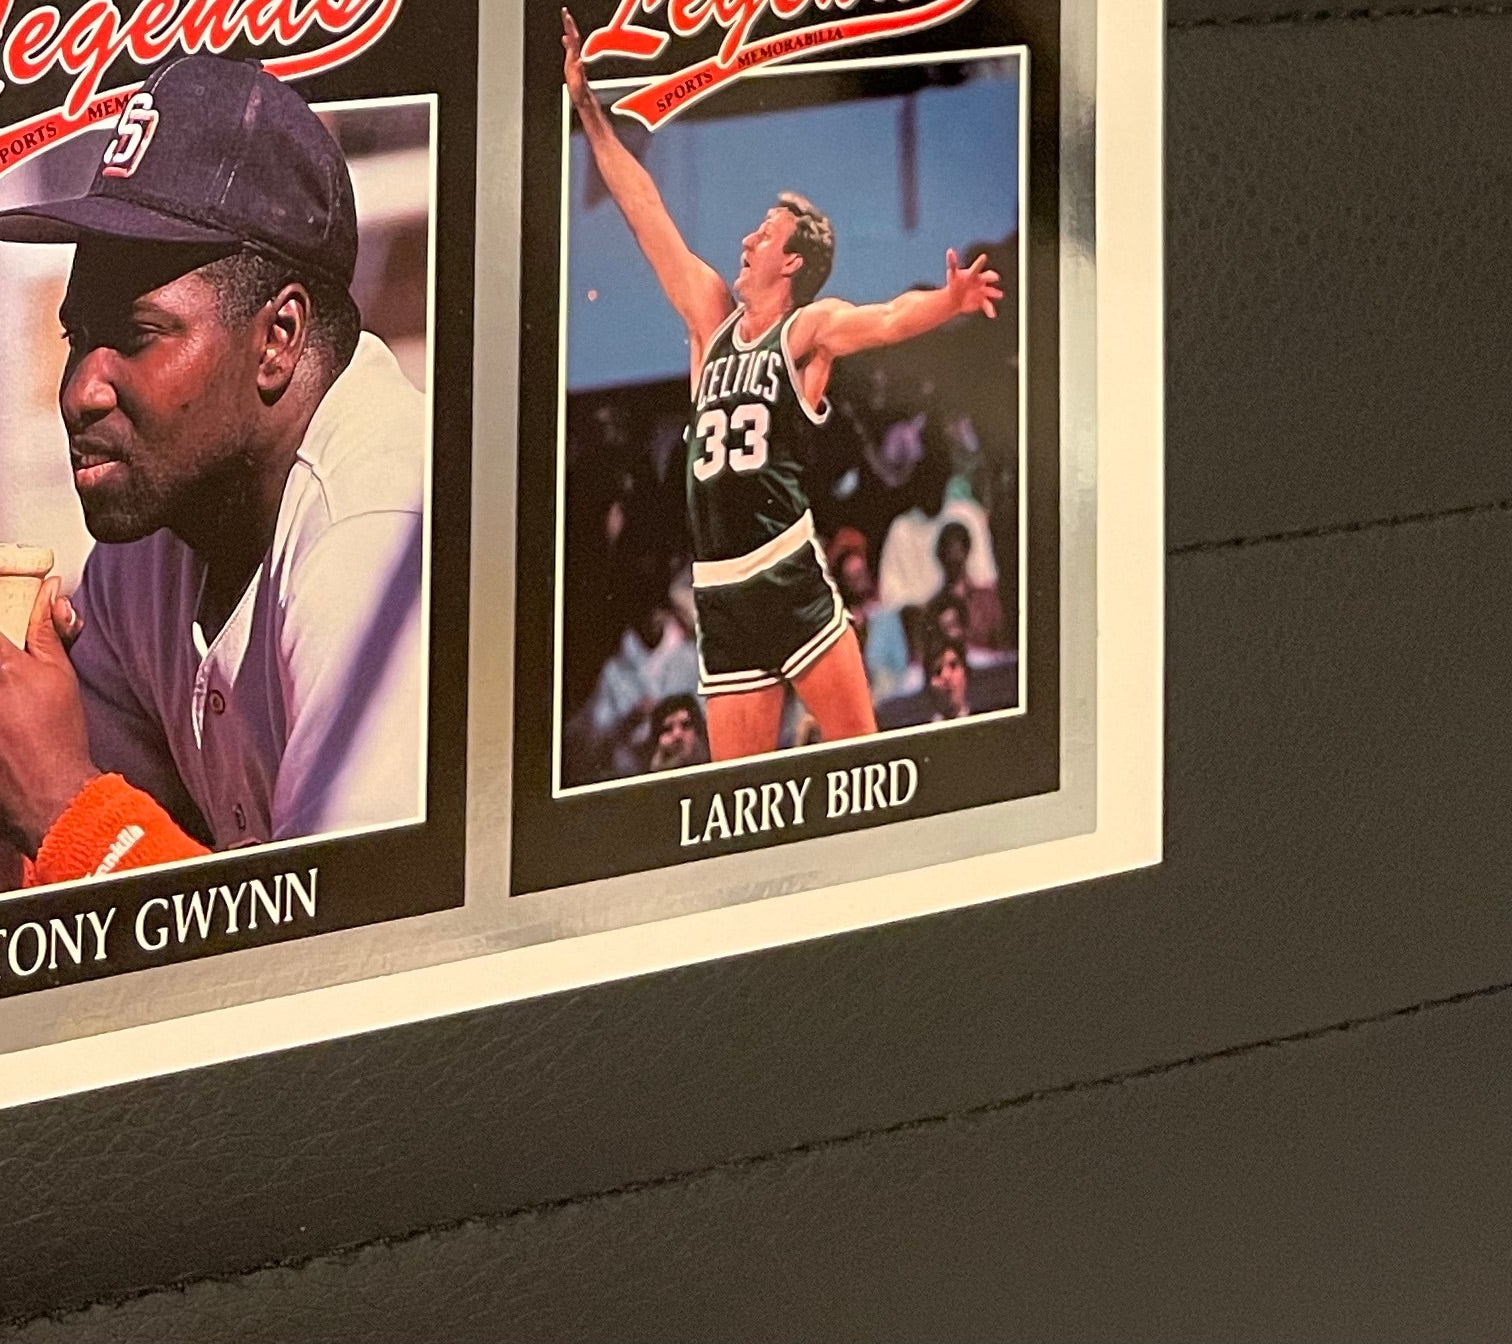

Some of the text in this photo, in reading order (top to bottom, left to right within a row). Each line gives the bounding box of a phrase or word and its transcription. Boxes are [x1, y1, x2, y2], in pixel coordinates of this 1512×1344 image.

[656, 26, 844, 113] SPORTS MEMORABILIA
[696, 351, 782, 412] CELTICS
[693, 403, 771, 482] 33
[679, 757, 920, 847] LARRY BIRD
[135, 868, 319, 951] GWYNN
